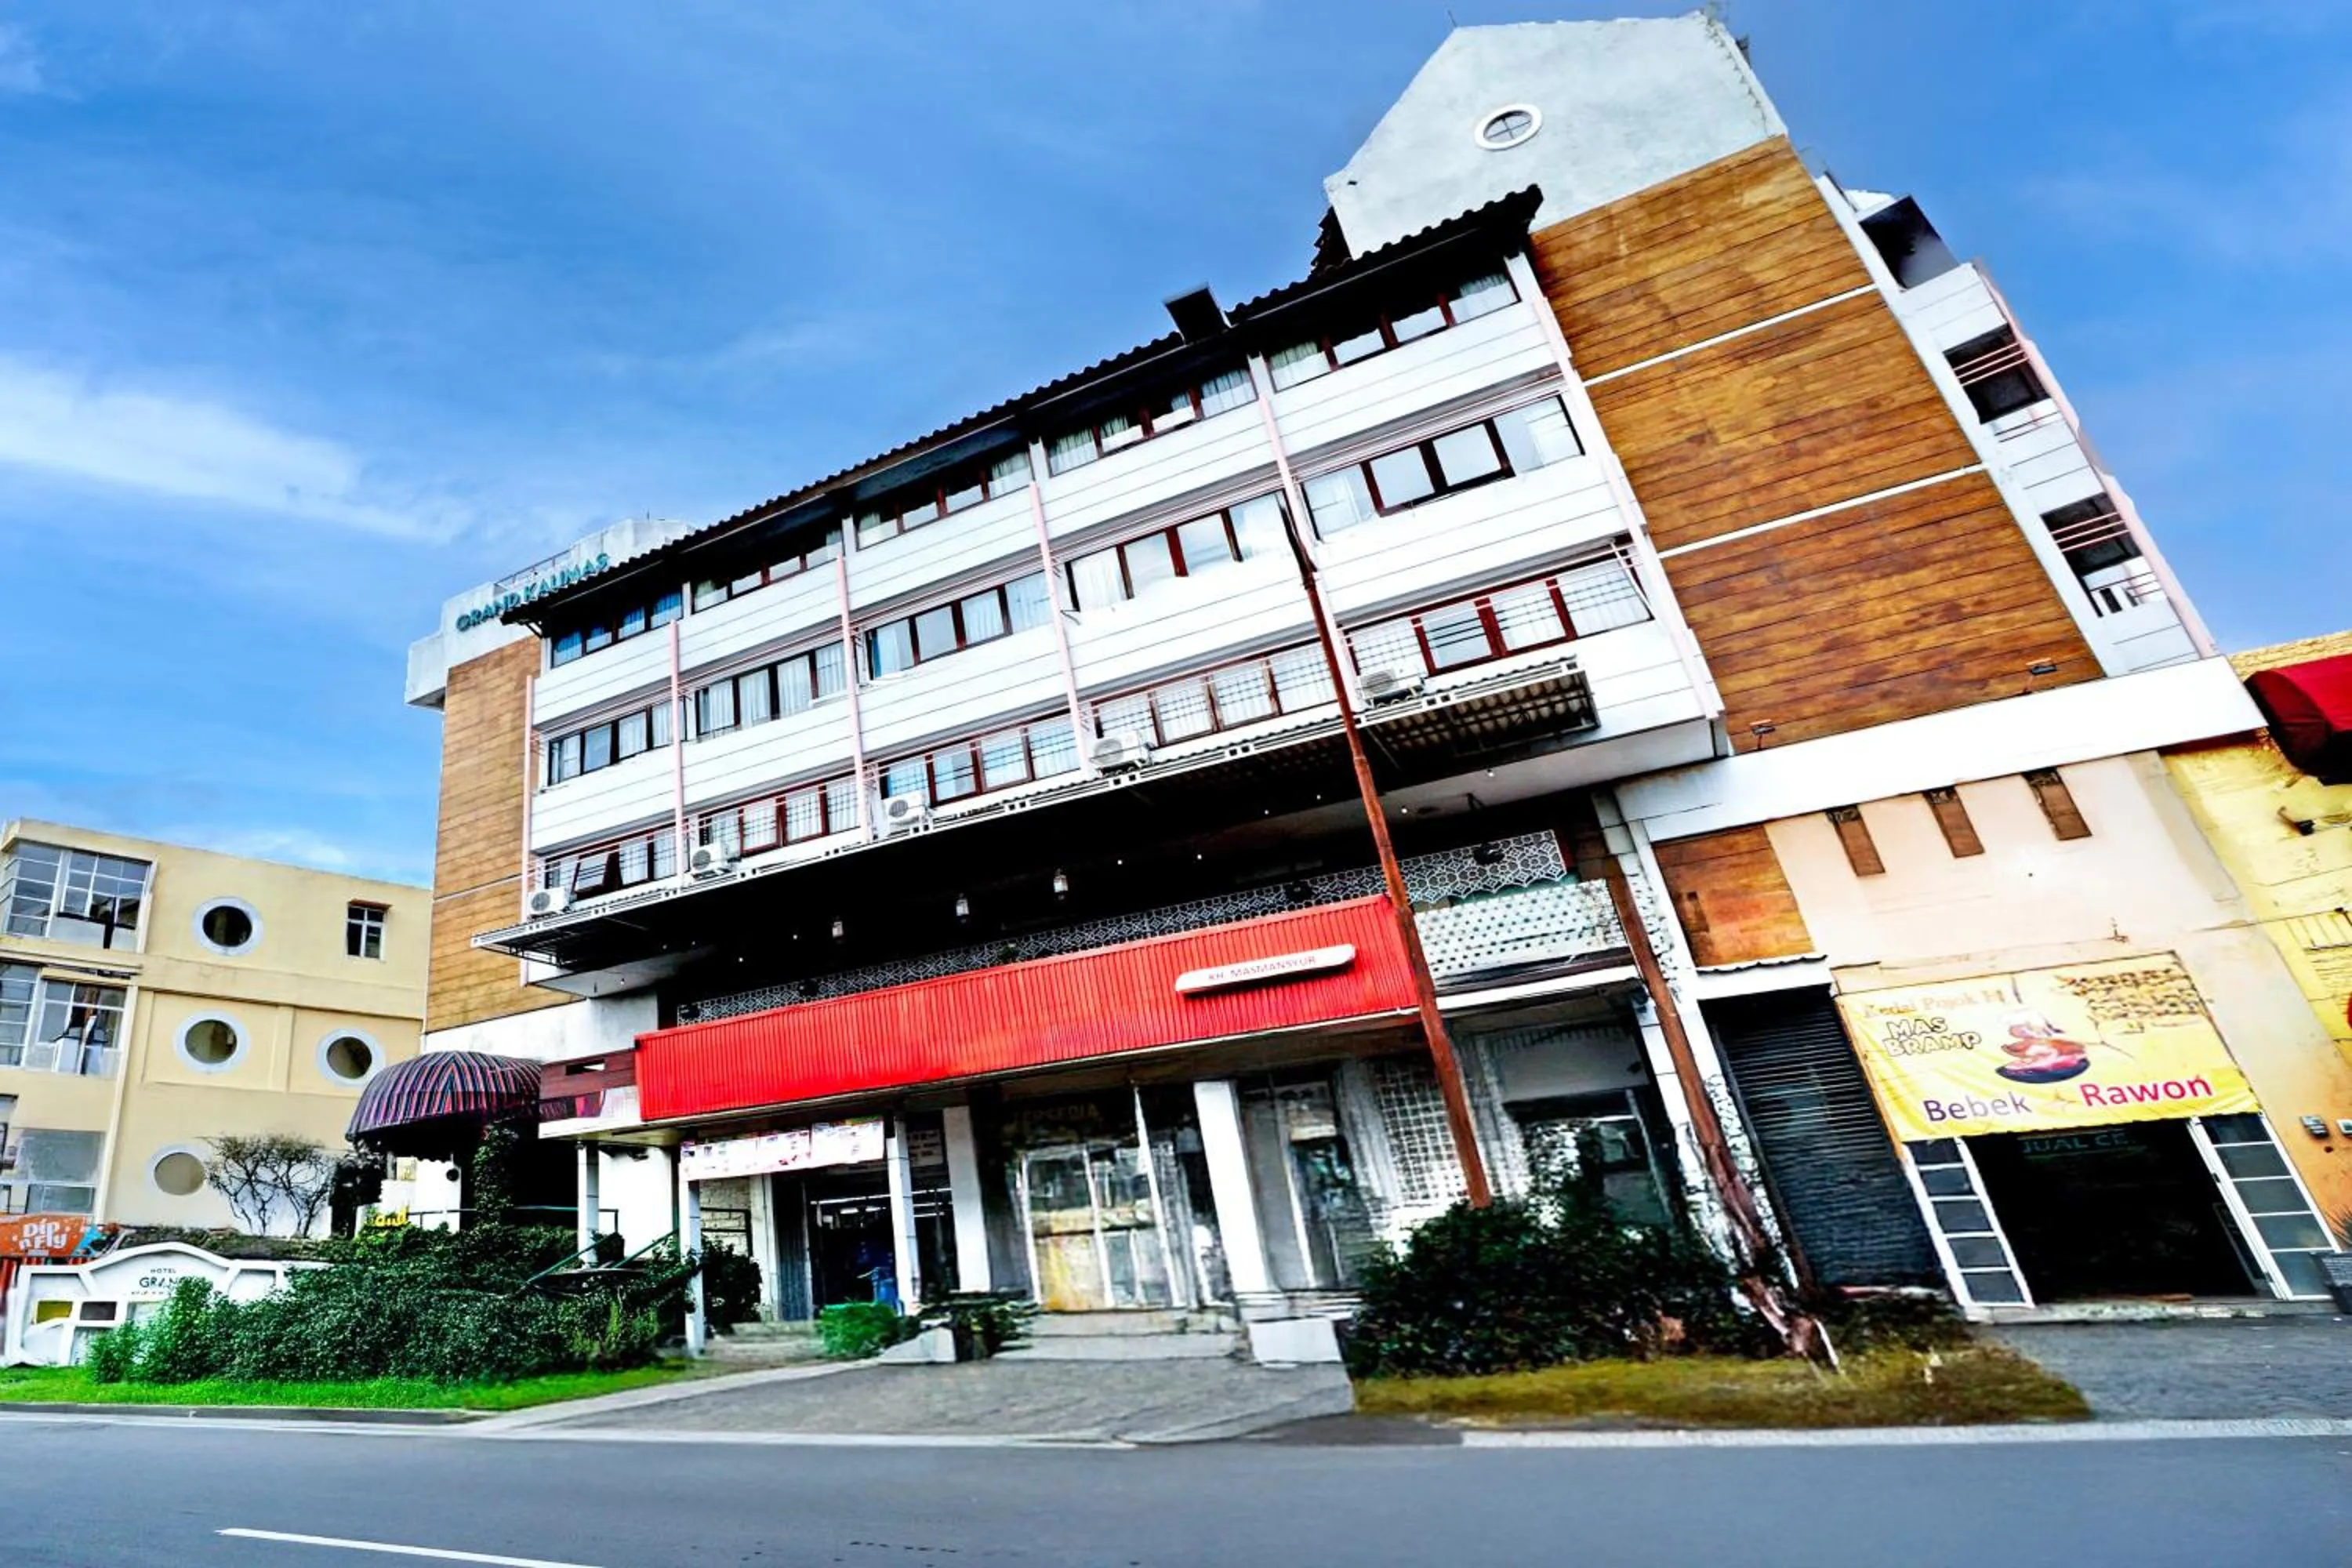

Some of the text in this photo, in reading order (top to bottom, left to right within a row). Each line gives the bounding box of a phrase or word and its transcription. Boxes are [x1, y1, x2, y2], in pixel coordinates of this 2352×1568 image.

[1886, 1017, 1948, 1039] MAS
[1923, 1091, 2033, 1122] Bebek
[2079, 1076, 2213, 1108] Rawon
